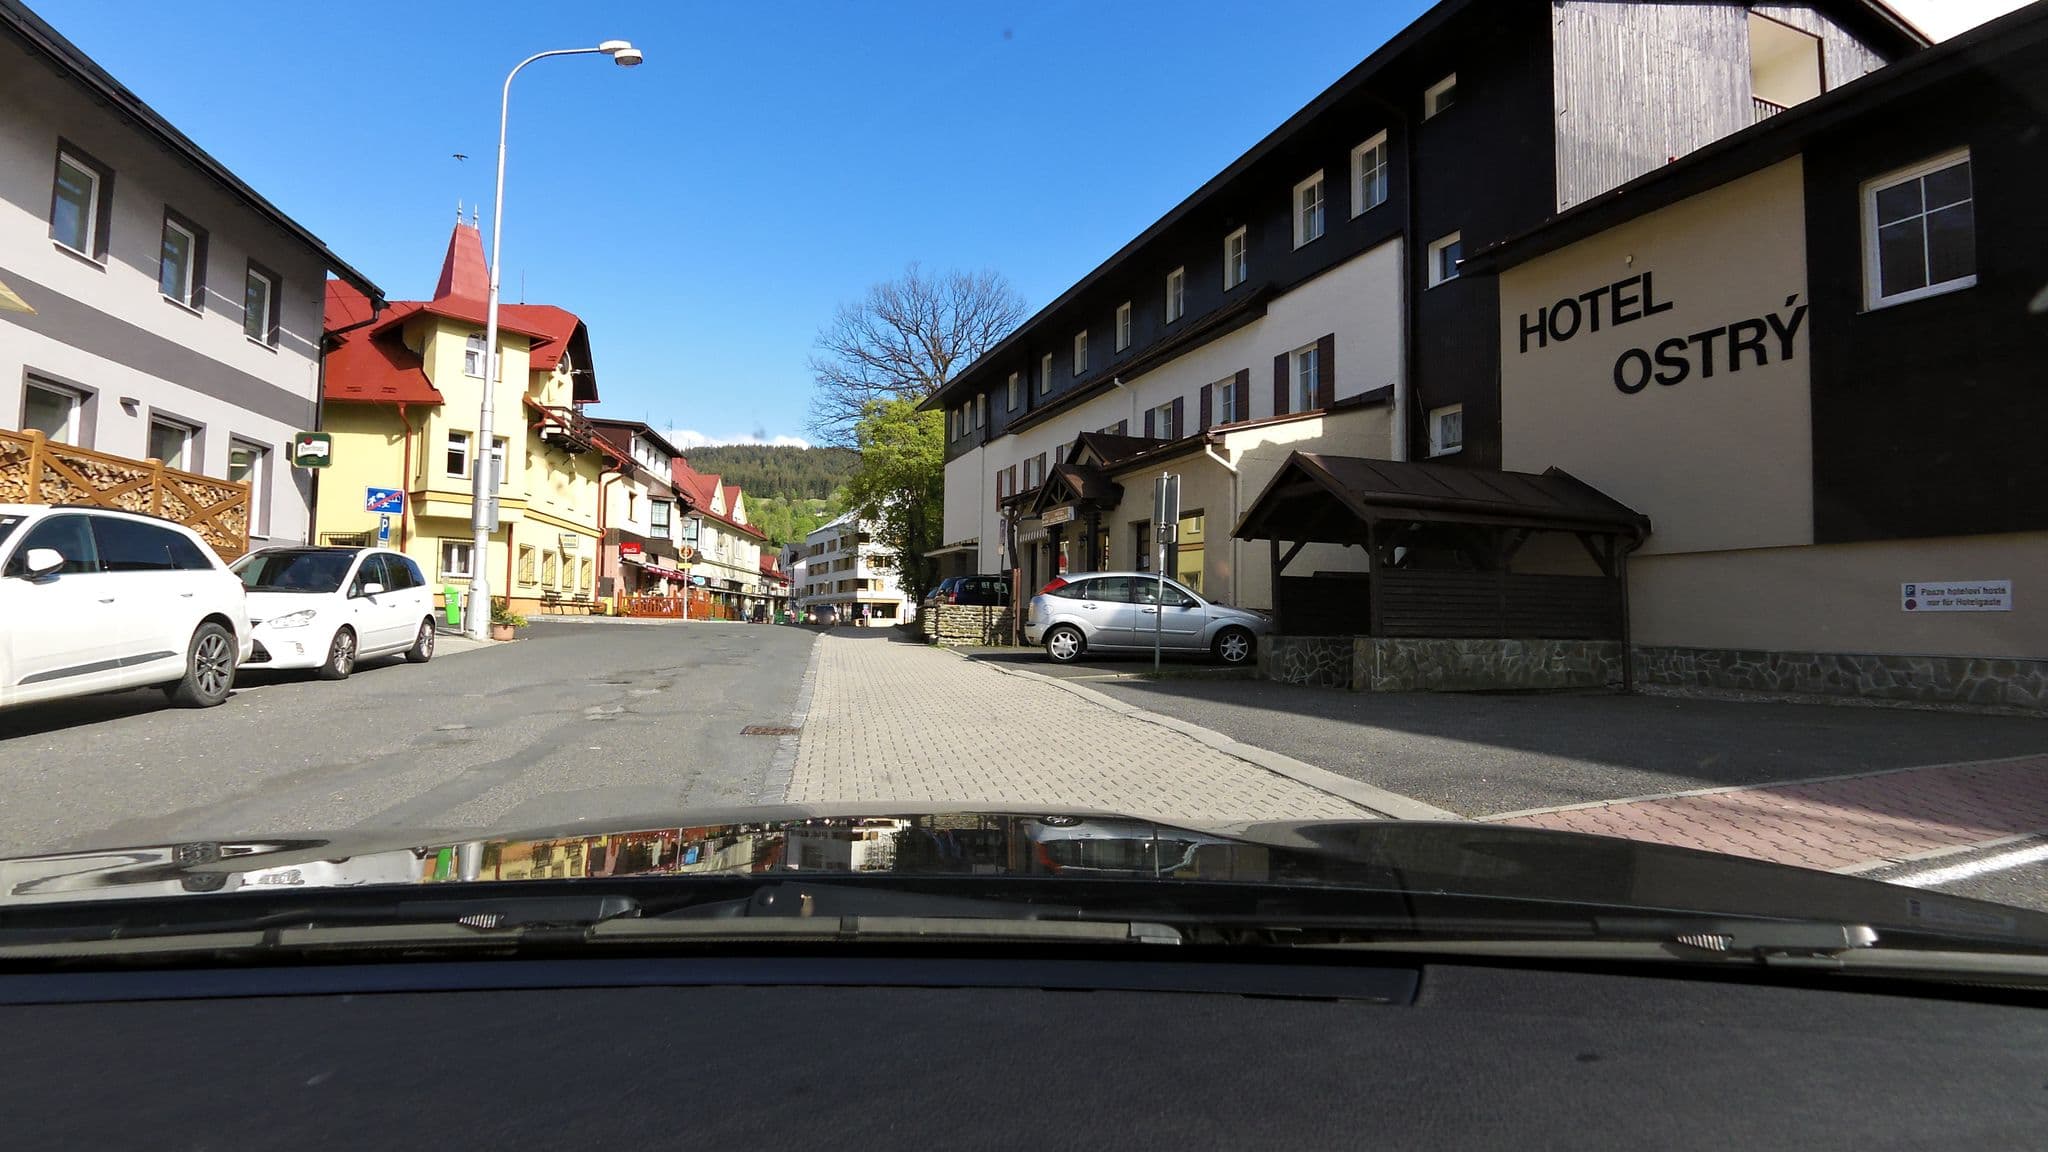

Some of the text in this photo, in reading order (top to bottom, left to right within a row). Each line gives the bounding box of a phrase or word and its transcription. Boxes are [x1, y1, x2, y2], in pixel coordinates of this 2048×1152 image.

[1519, 271, 1674, 354] HOTEL
[1613, 293, 1809, 395] OSTRÝ
[382, 518, 389, 532] P
